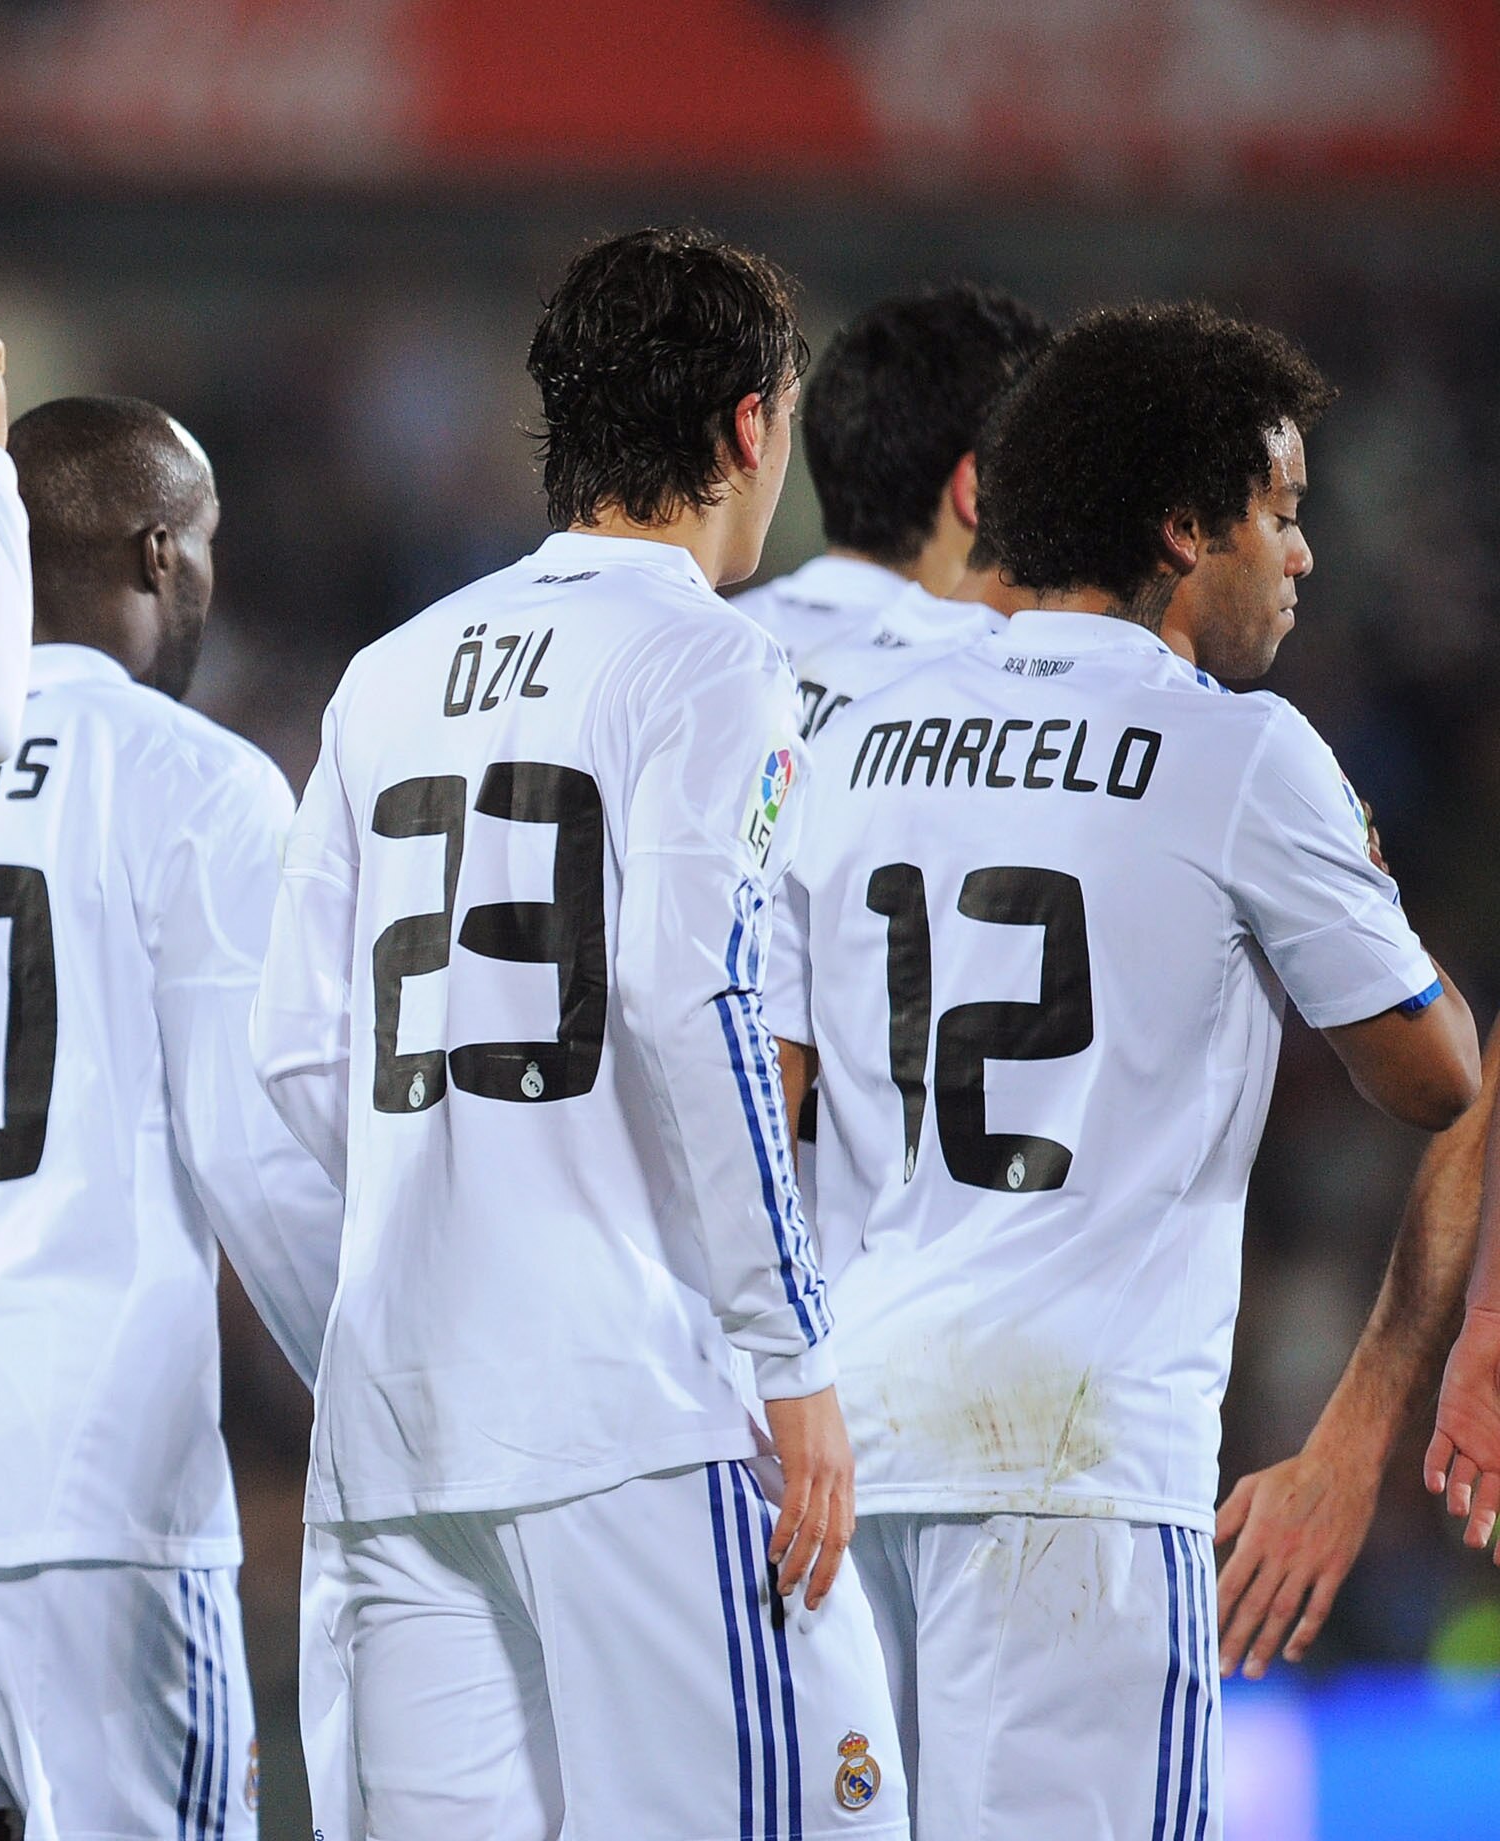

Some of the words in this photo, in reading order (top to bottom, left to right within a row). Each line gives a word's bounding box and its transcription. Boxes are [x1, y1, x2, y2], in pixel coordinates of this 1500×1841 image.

[443, 623, 554, 718] ÖZIL
[1027, 658, 1075, 677] MADRID
[849, 717, 1162, 800] MARCELO
[371, 761, 608, 1115] 23
[865, 862, 1095, 1193] 12
